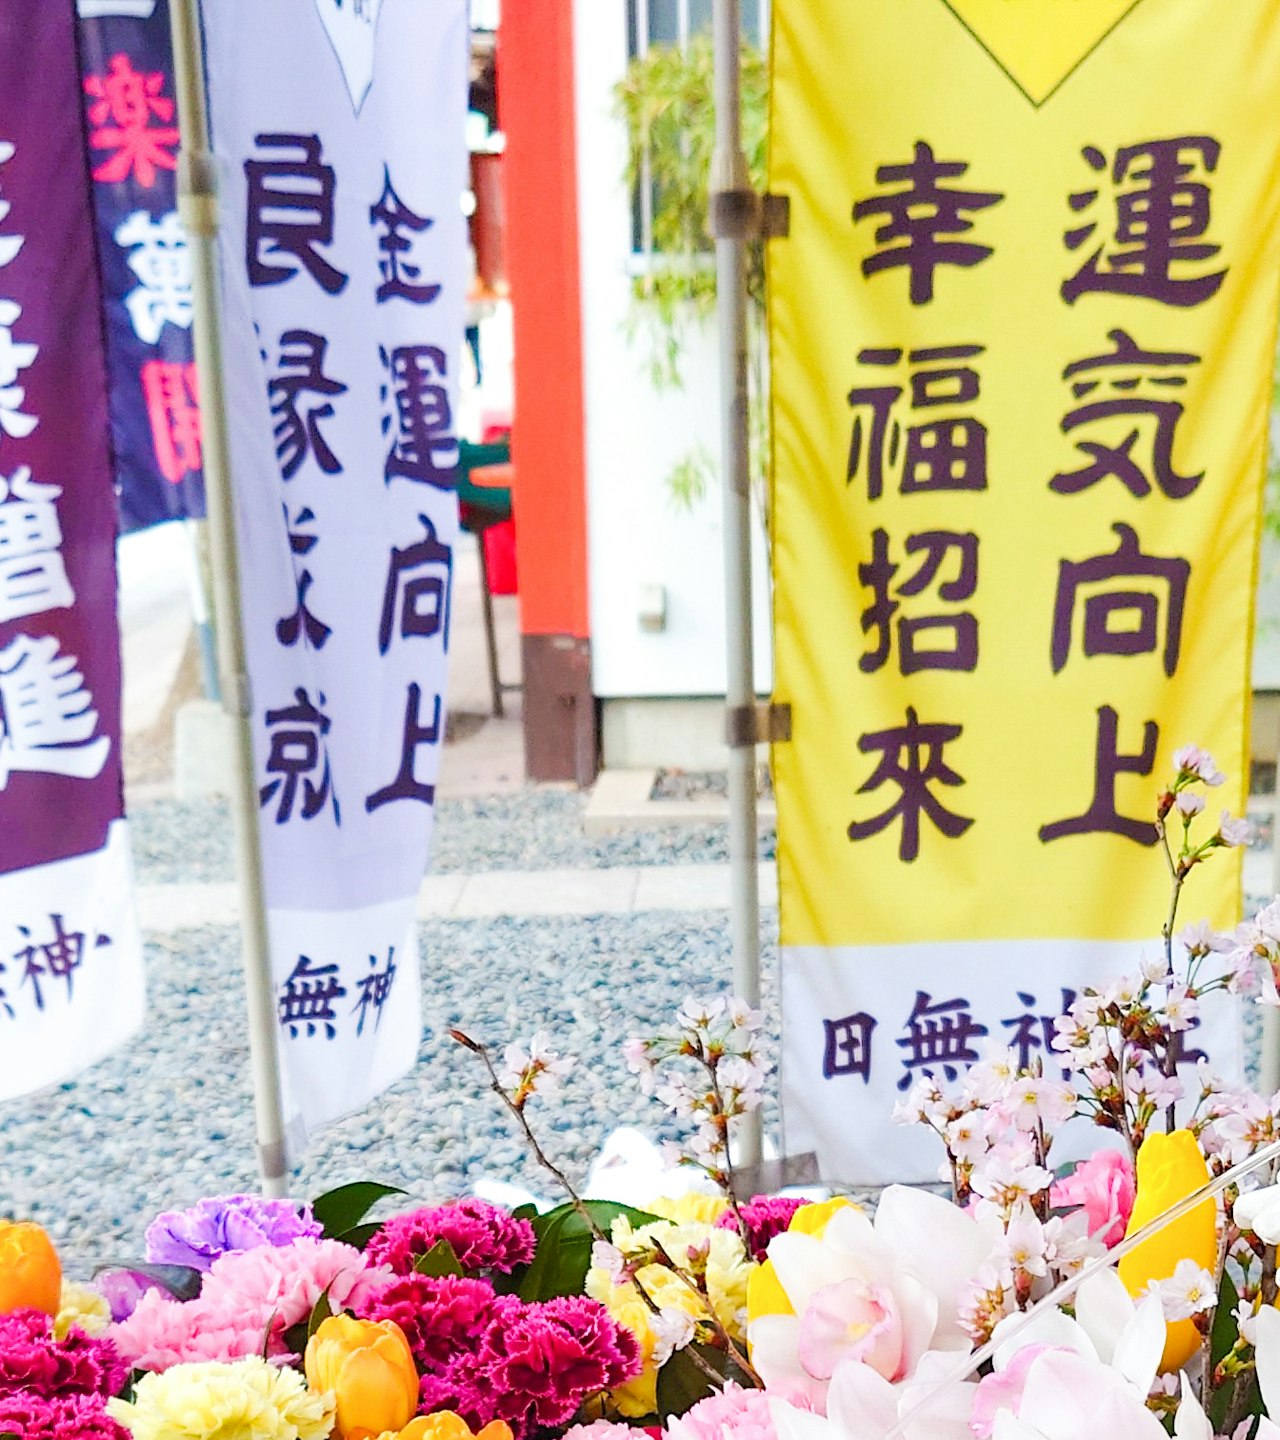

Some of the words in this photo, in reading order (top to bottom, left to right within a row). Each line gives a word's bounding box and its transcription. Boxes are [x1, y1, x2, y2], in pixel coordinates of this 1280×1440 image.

[365, 162, 458, 812] 金運向上
[1038, 135, 1230, 848] 運気向上
[822, 988, 1209, 1092] 田無神
